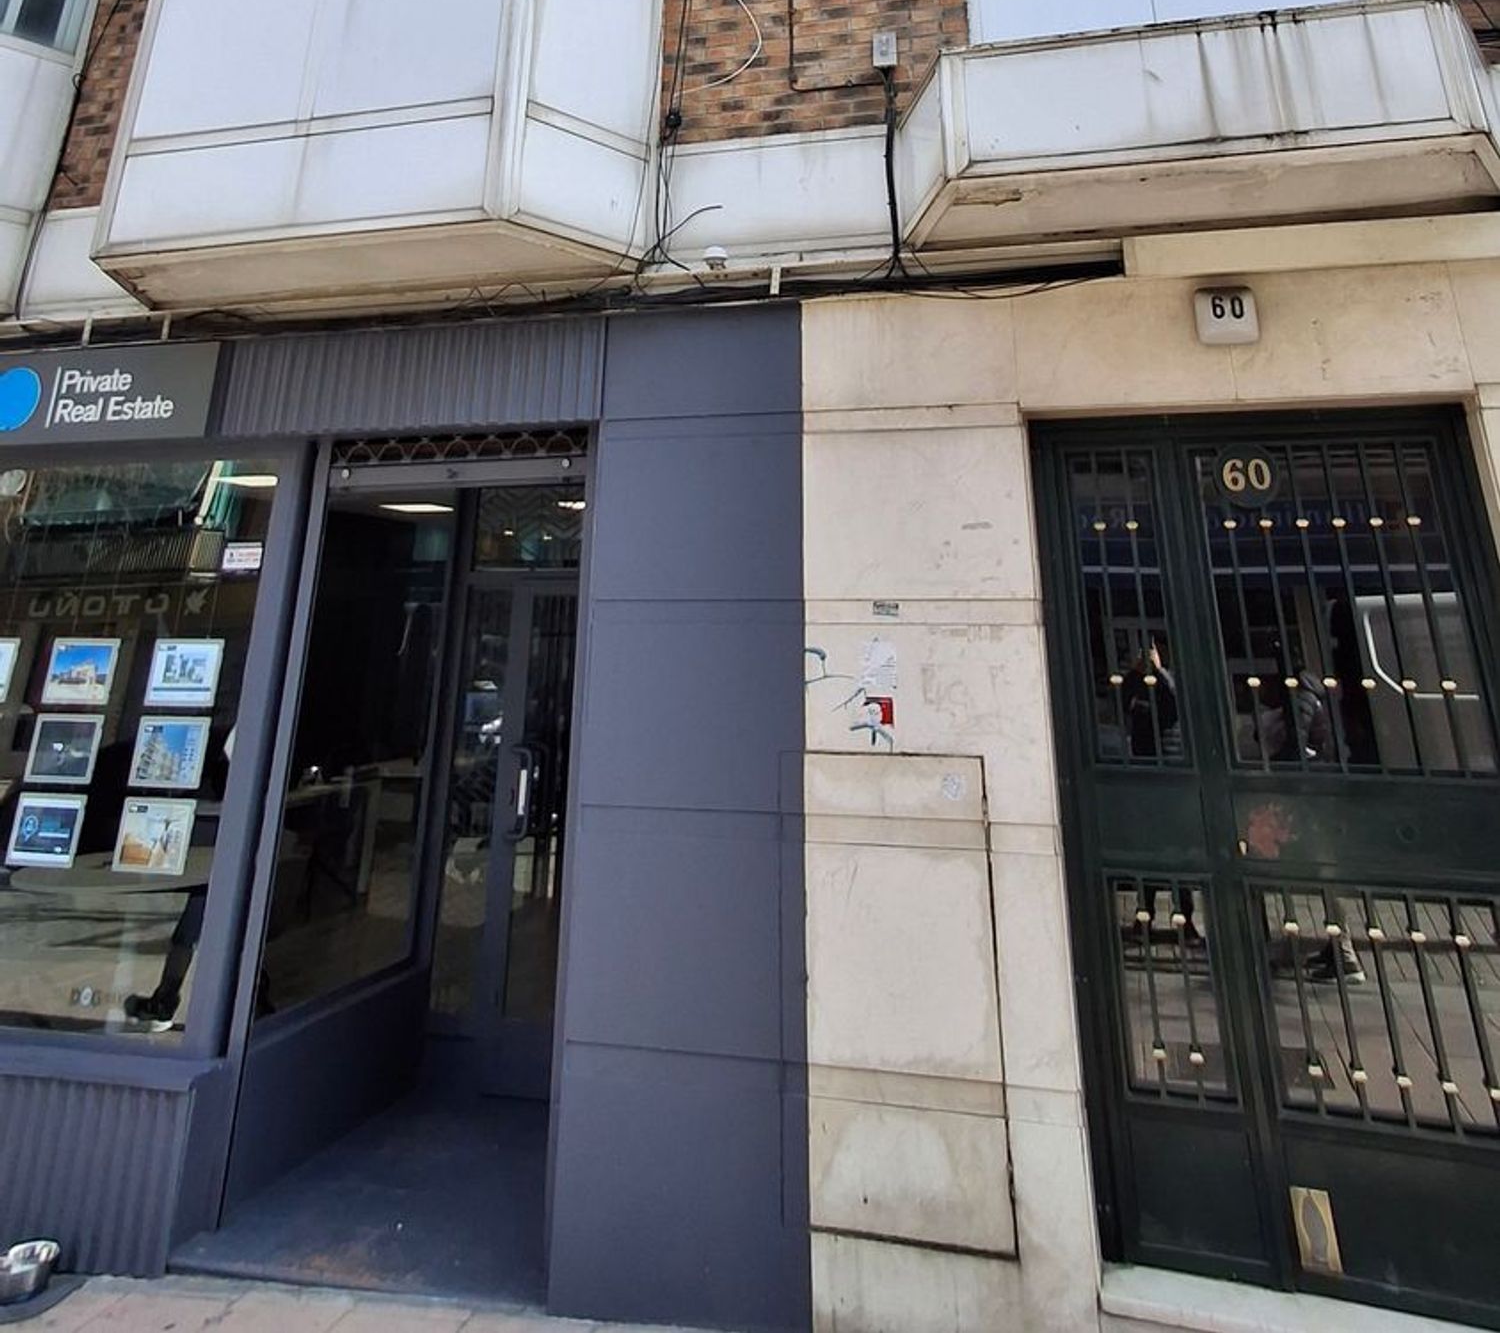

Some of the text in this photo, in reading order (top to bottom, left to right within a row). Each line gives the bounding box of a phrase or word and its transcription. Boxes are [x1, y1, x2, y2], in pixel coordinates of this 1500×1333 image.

[1211, 295, 1245, 320] 60
[61, 368, 133, 395] Private
[54, 393, 174, 423] Real Estate
[1221, 457, 1272, 492] 60
